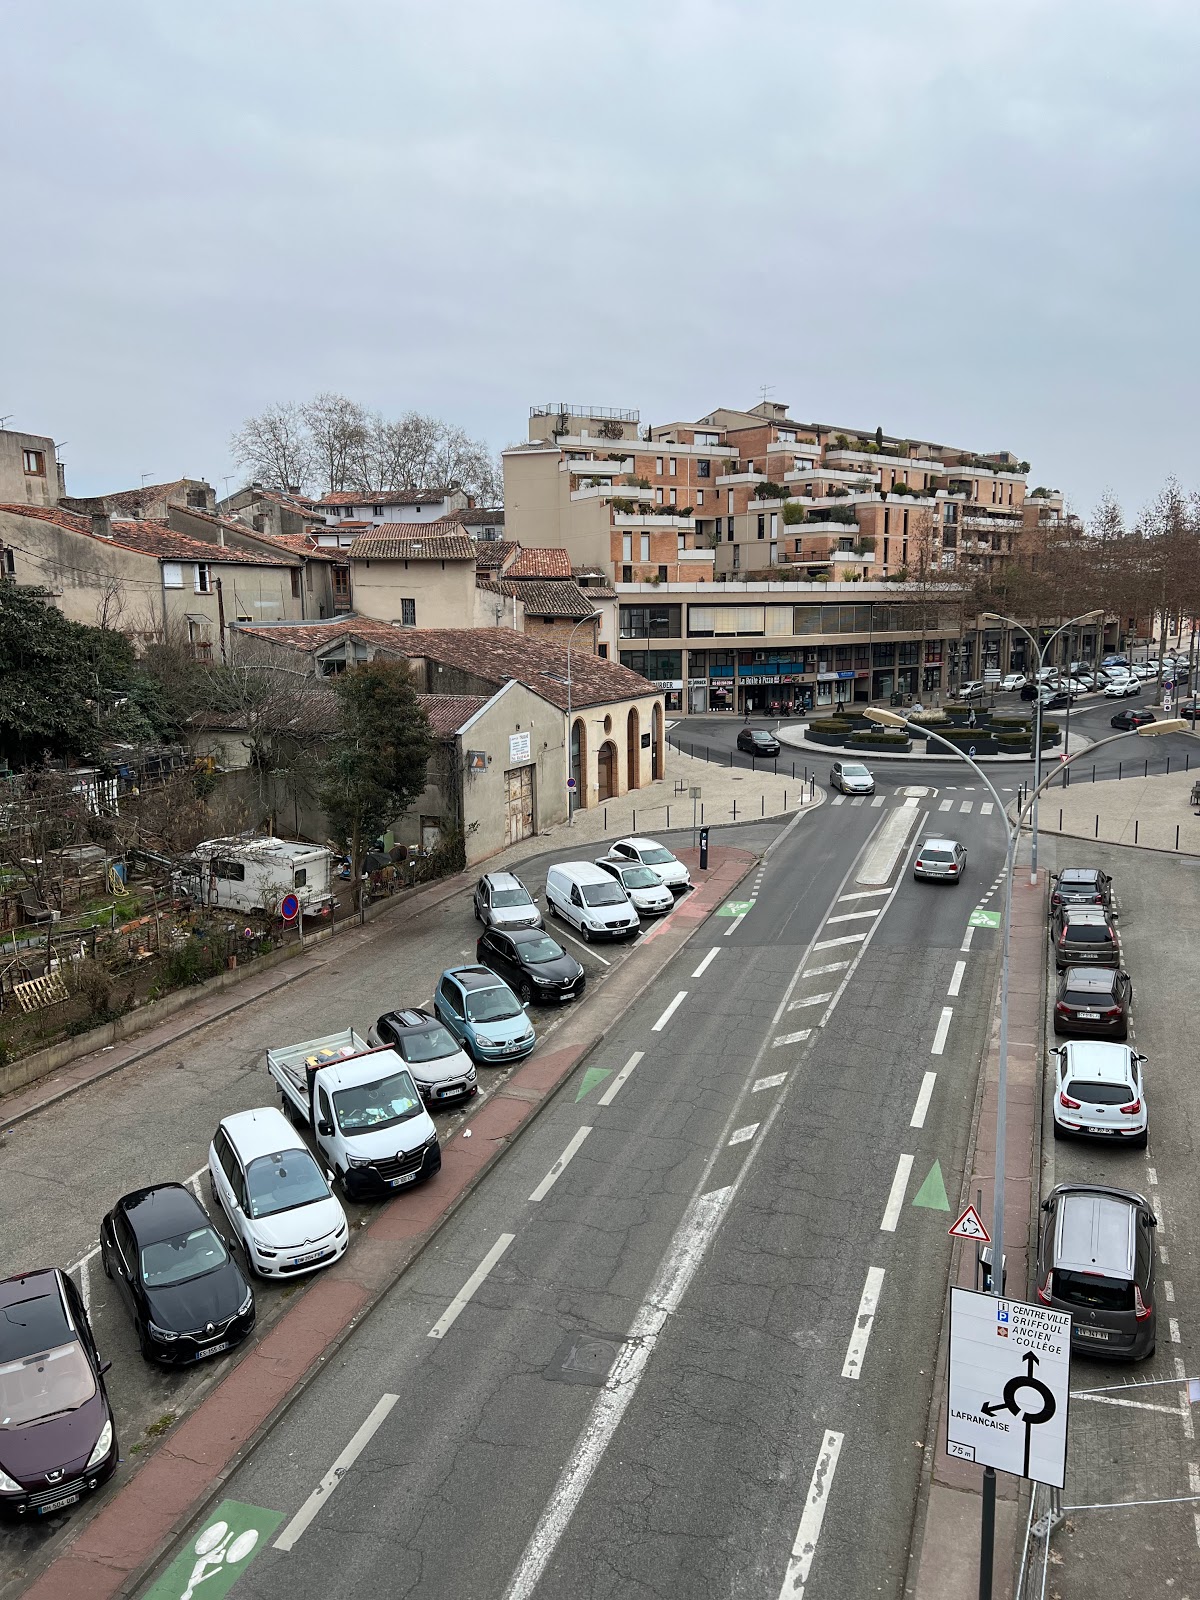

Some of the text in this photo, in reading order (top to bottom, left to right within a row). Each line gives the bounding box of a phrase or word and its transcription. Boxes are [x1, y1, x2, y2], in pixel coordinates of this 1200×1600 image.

[1012, 1306, 1070, 1326] CENTRE VILLE
[1012, 1316, 1062, 1334] GRIFFOUL
[1012, 1326, 1051, 1342] ANCIEN
[952, 1445, 964, 1454] 75
